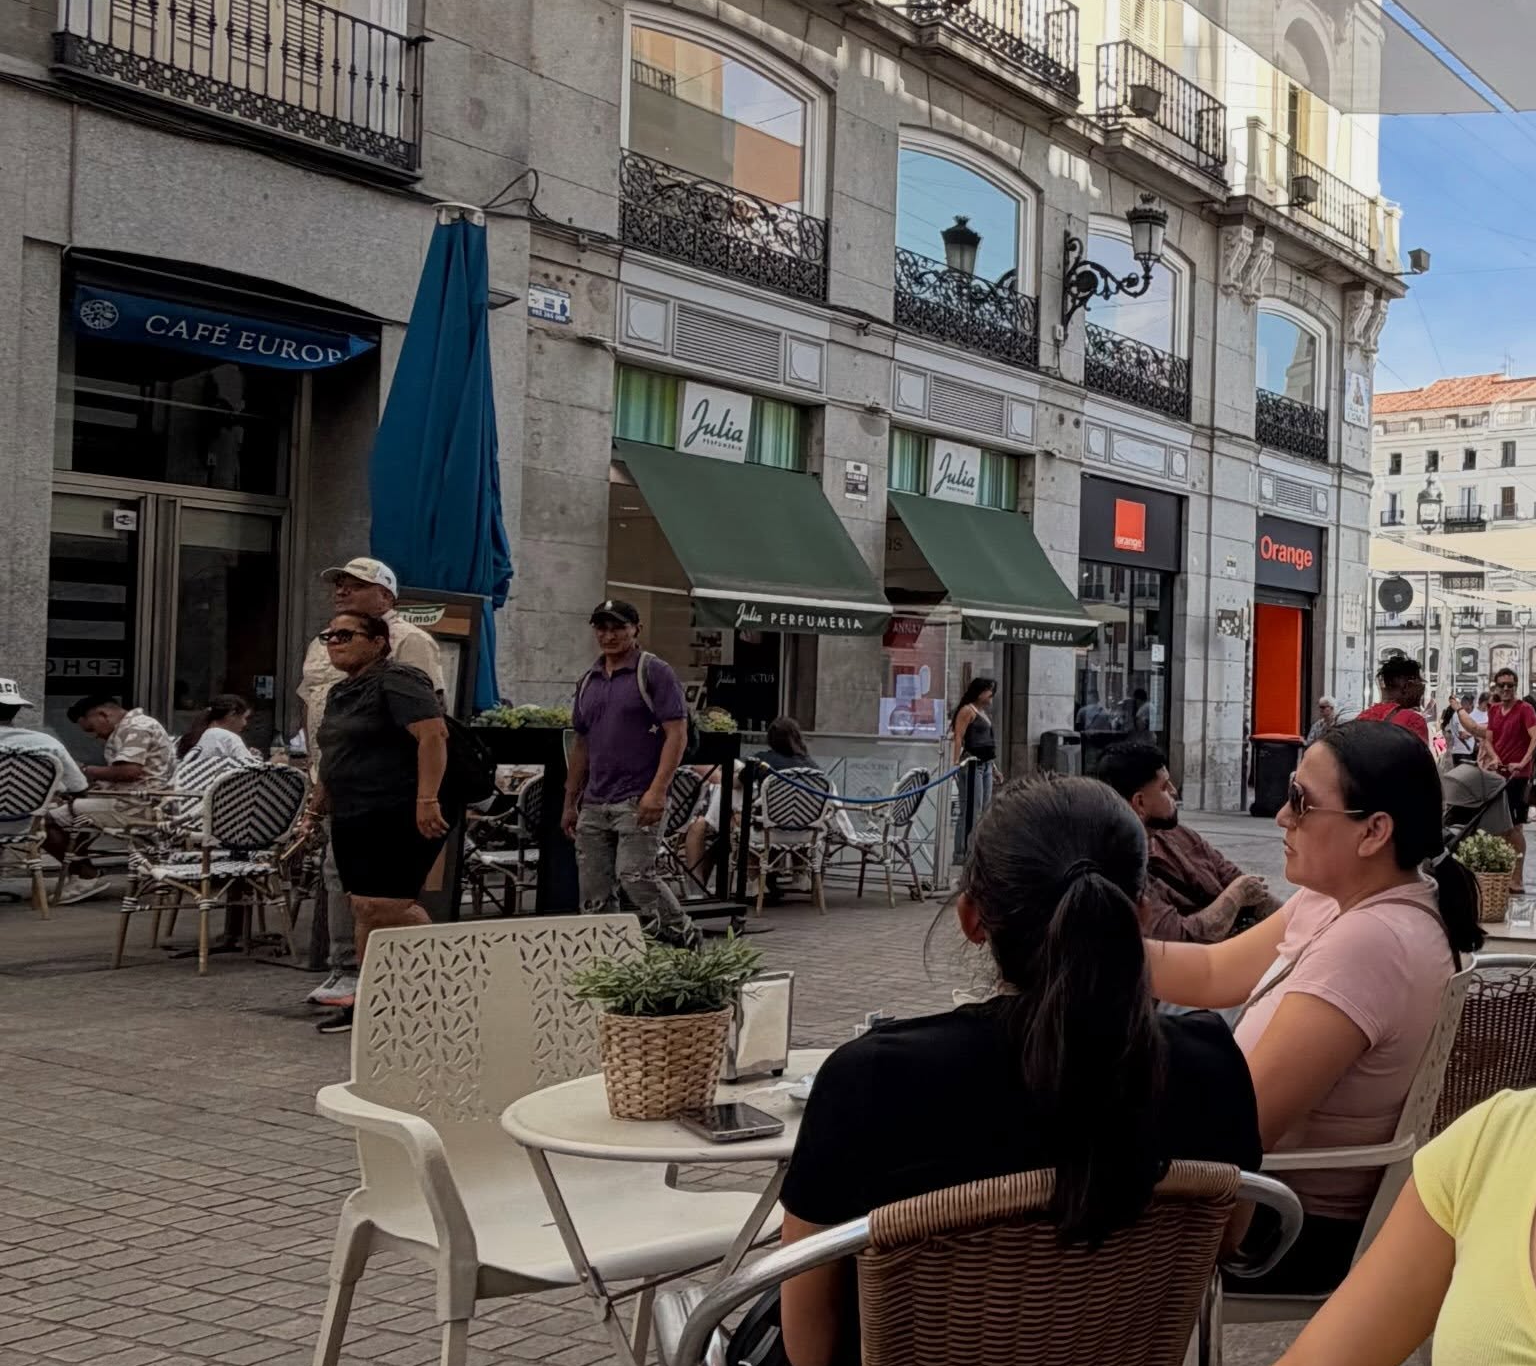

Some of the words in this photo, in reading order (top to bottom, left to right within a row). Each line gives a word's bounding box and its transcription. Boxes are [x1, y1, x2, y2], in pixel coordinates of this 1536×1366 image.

[145, 314, 231, 346] CAFÉ
[237, 331, 351, 364] EUROP
[684, 398, 743, 448] Julia
[934, 452, 976, 494] Julia
[1260, 535, 1313, 570] Orange
[735, 602, 763, 627] Julia
[770, 612, 863, 630] PERFUMERIA
[1012, 627, 1073, 642] PERFUMERIA
